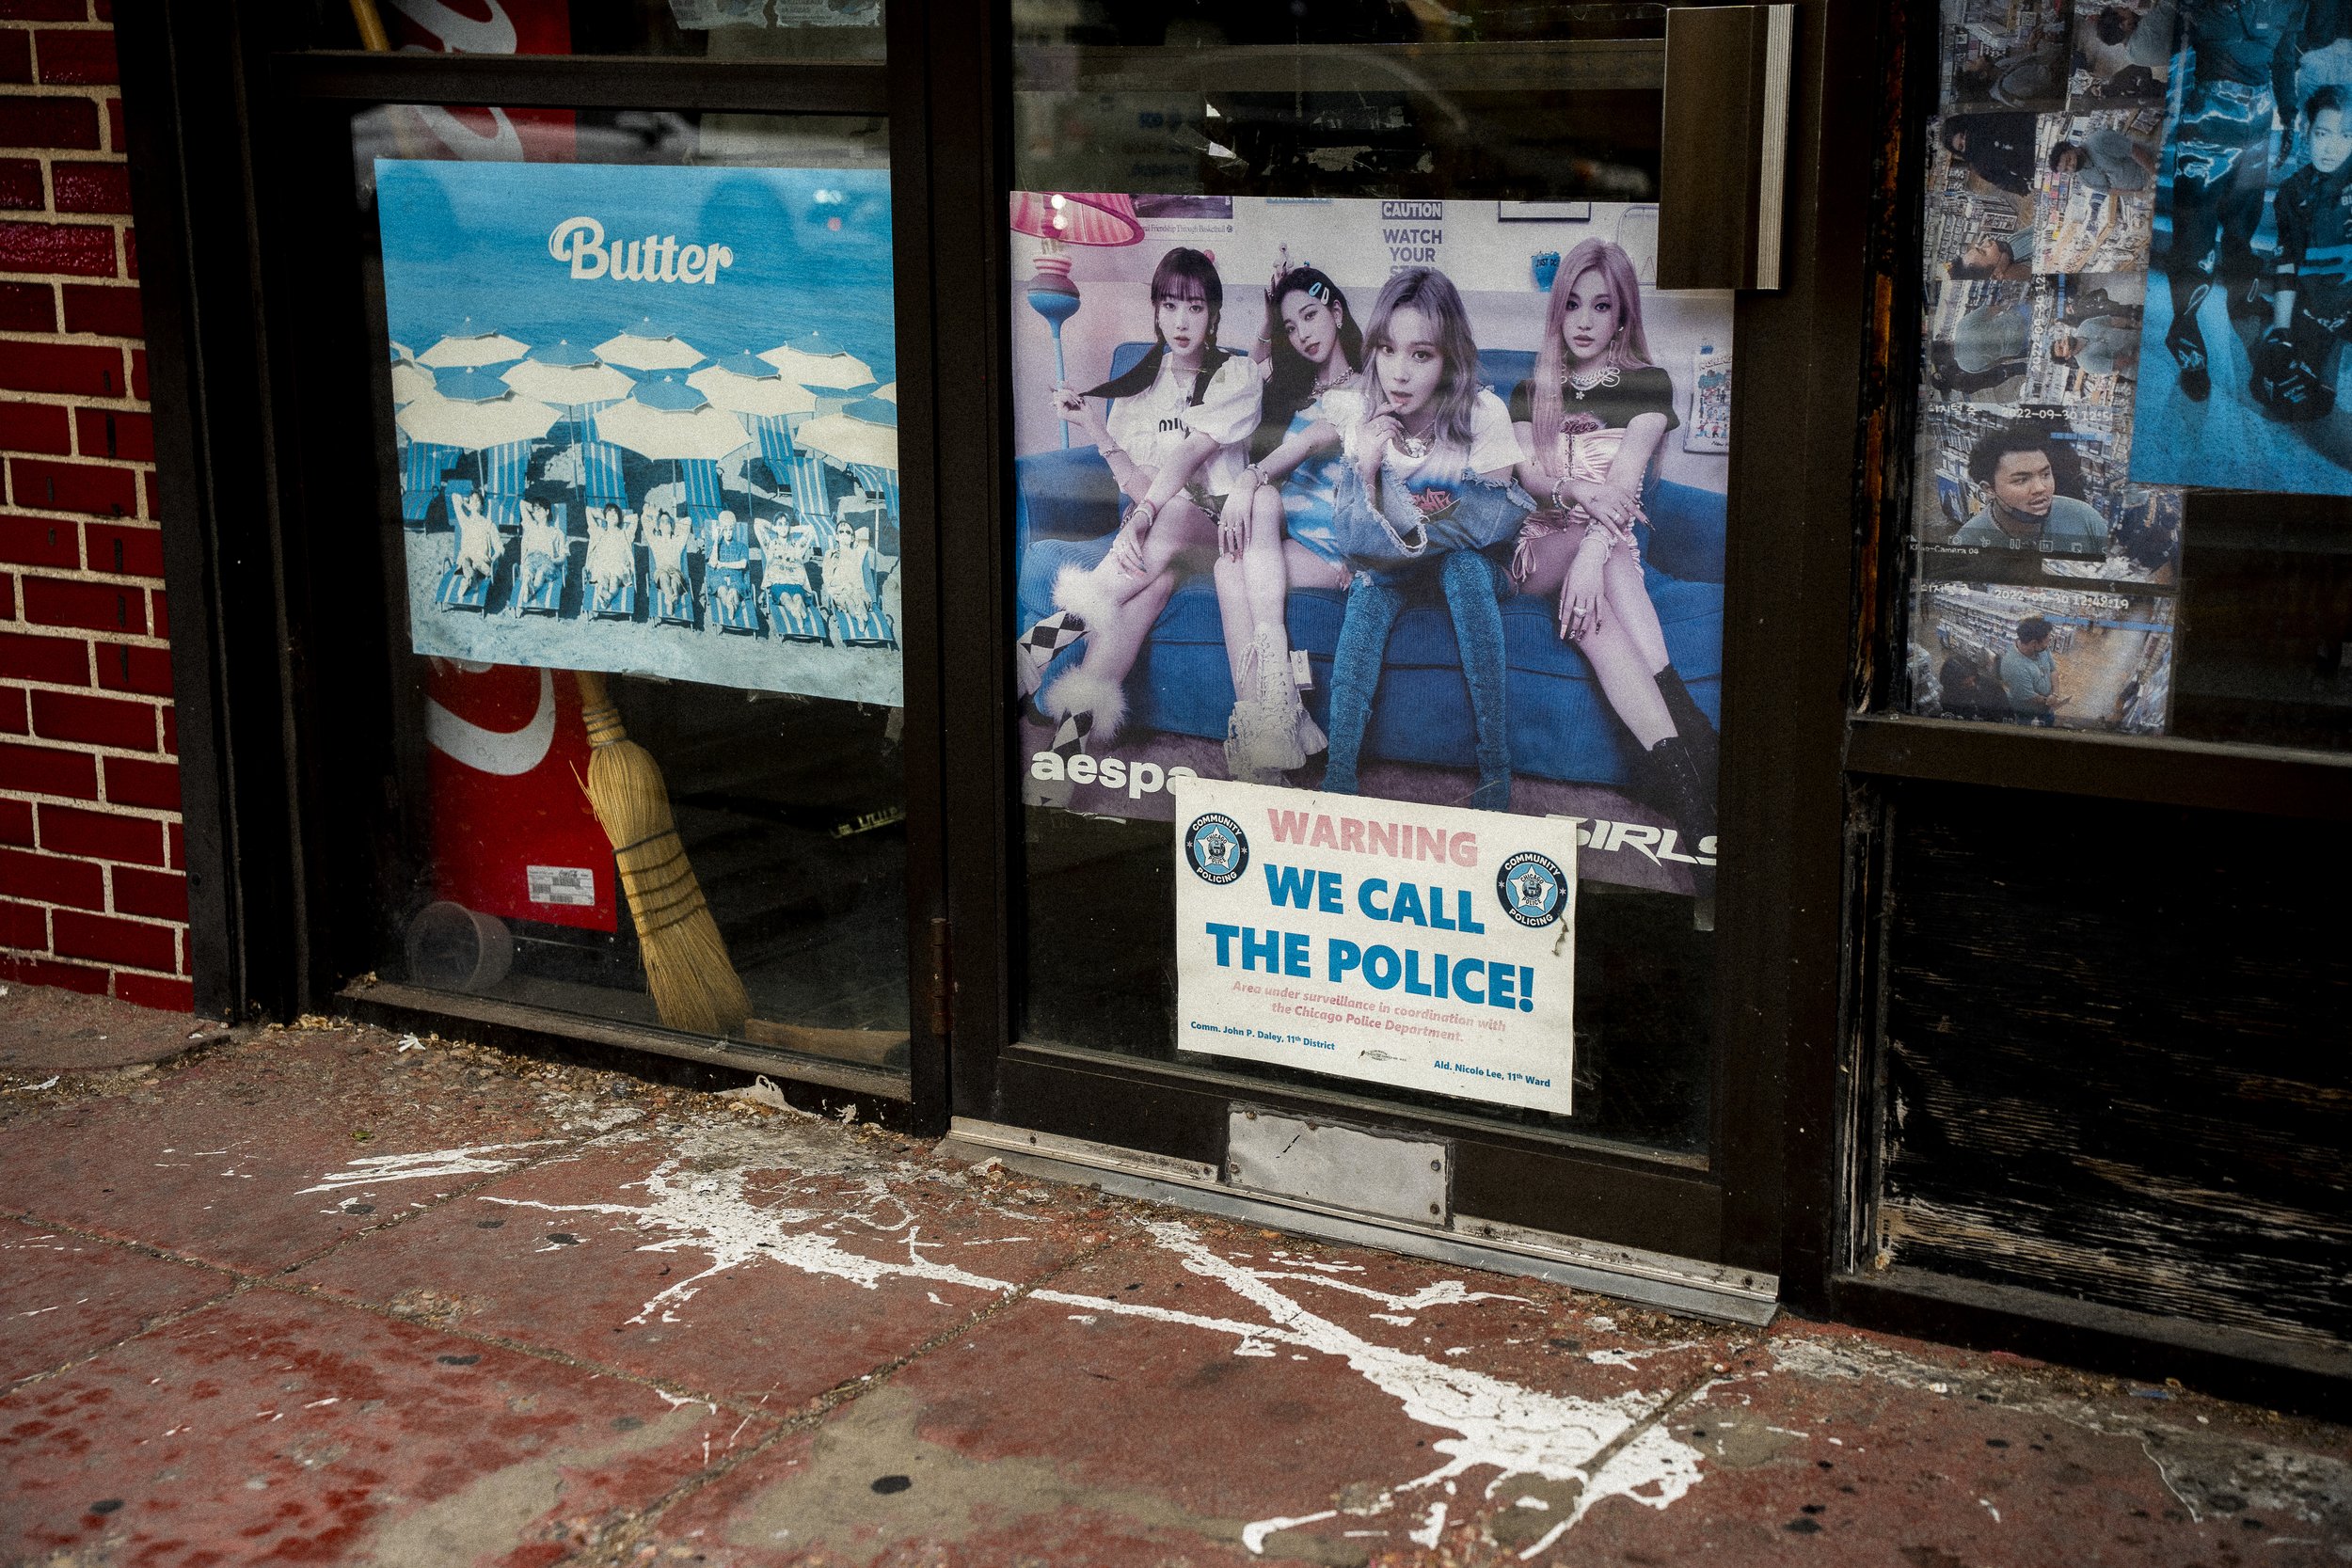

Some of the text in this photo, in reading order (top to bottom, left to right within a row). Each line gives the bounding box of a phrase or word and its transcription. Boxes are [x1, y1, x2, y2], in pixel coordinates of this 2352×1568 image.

[1383, 202, 1441, 217] CAUTION
[1382, 229, 1442, 244] WATCH
[548, 216, 733, 285] Butter
[1390, 247, 1436, 262] YOUR
[2001, 408, 2077, 420] 2022-09-30
[1994, 589, 2069, 604] 2022-09-30
[1192, 815, 1242, 836] COMMUNITY
[1206, 833, 1228, 845] CHICAGO
[1267, 808, 1478, 867] WARNING
[1208, 855, 1226, 863] POLICE
[1504, 853, 1561, 876] COMMUNITY
[1197, 867, 1237, 883] POLICING
[1519, 873, 1545, 885] CHICAGO
[1263, 863, 1485, 935] WE CALL
[1521, 896, 1542, 906] POLICE
[1509, 908, 1553, 927] POLICING
[1205, 922, 1534, 1013] THE POLICE!
[1232, 980, 1506, 1032] Area under surveillance in coordination with
[1272, 1002, 1464, 1042] the Chicago Police Department.
[1190, 1021, 1336, 1051] Comm. John P. Daley, 11th District
[1434, 1060, 1453, 1070] Ald.
[1486, 1069, 1504, 1081] Lee,
[1507, 1072, 1523, 1082] 11th
[1525, 1075, 1550, 1087] Ward
